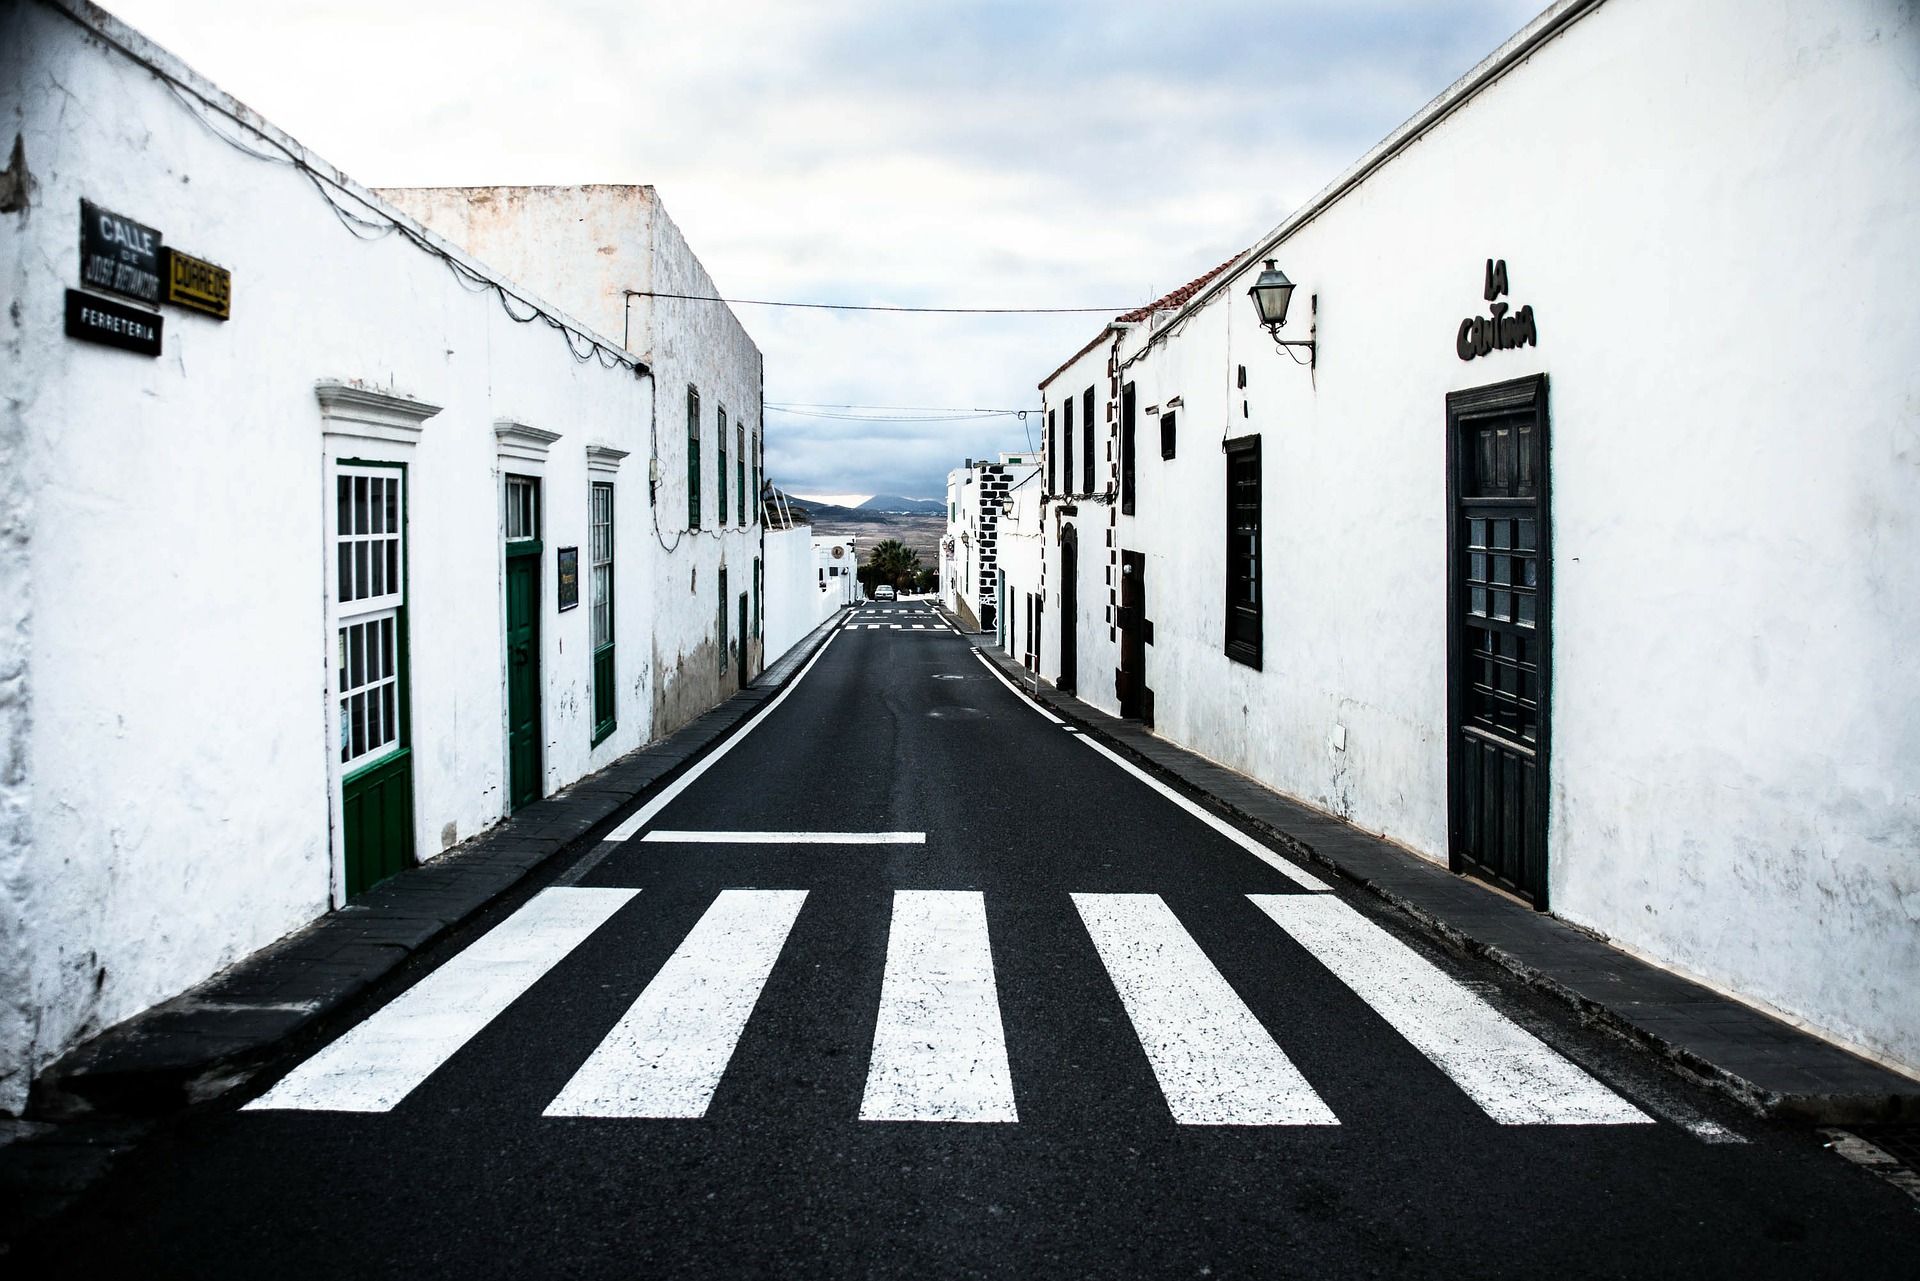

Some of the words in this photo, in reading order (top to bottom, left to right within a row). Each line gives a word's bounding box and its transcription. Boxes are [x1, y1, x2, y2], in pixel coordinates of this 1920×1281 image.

[99, 217, 154, 256] CALLE
[120, 250, 138, 264] DE
[175, 259, 229, 300] CORREOS
[1484, 258, 1508, 301] LA
[81, 308, 154, 341] FERRETERIA
